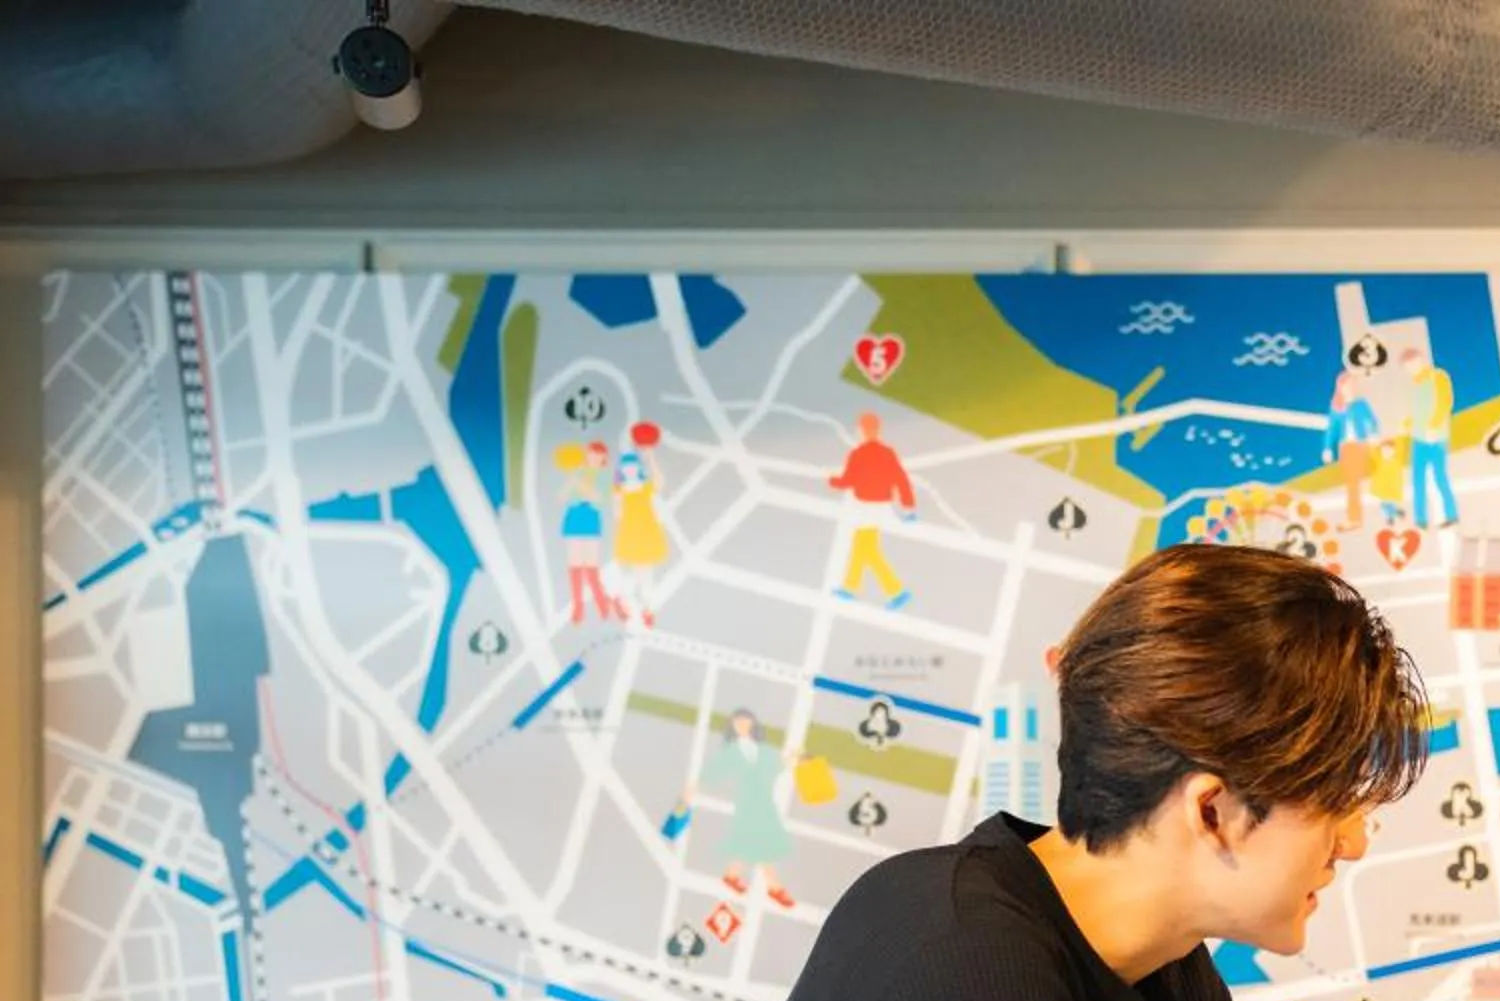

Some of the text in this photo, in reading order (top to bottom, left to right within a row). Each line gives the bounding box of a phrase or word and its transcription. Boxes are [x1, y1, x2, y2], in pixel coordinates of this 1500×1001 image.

[1389, 537, 1407, 562] K
[1452, 790, 1472, 817] K
[1457, 851, 1476, 879] J
